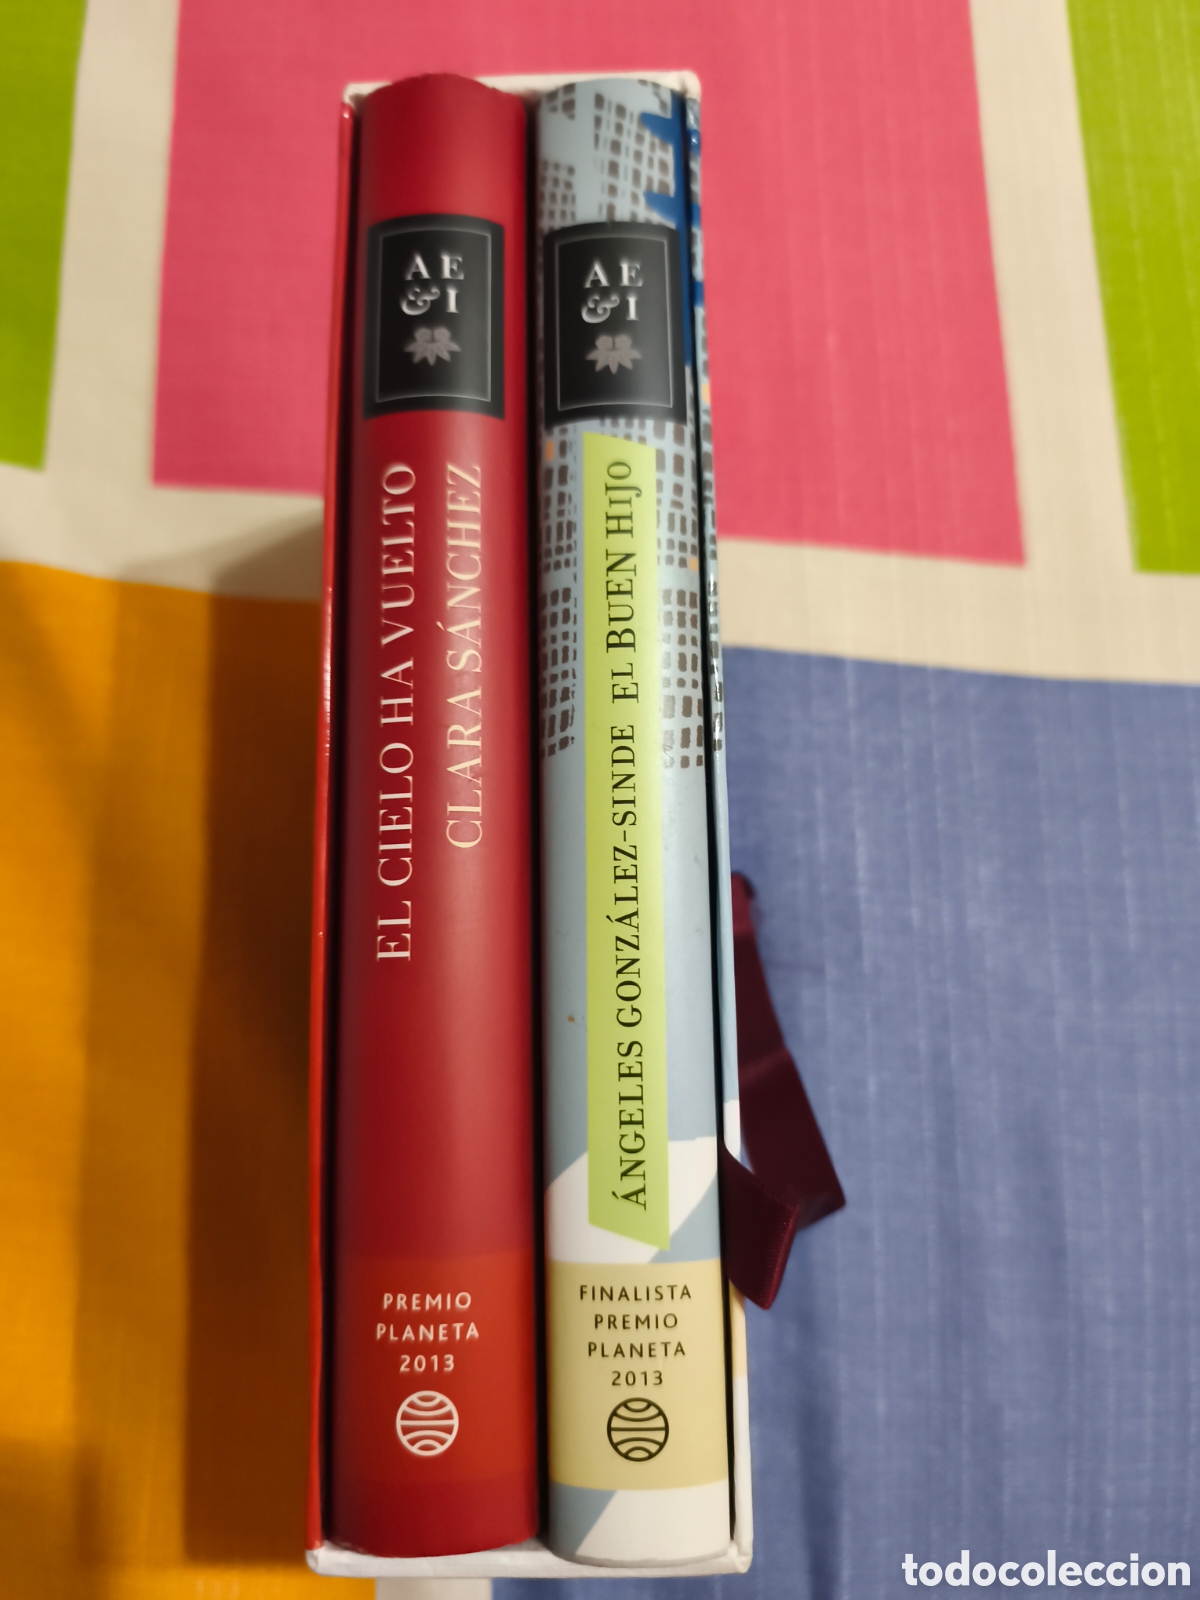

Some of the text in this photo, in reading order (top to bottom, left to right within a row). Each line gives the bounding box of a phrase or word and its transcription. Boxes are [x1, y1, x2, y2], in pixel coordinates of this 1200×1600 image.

[605, 548, 637, 654] BUEN
[435, 462, 483, 849] CLARA SÁNCHEZ
[610, 662, 639, 704] EL
[376, 462, 417, 962] EL CIELO HA VUELTO
[605, 723, 643, 1028] GONZÁLEZ-SINDE
[611, 1039, 647, 1211] ÁNGELES
[382, 1291, 473, 1311] PREMIO
[579, 1284, 692, 1302] FINALISTA
[375, 1321, 480, 1342] PLANETA
[593, 1312, 679, 1331] PREMIO
[587, 1341, 687, 1359] PLANETA
[399, 1354, 456, 1372] 2013
[611, 1370, 664, 1387] 2013
